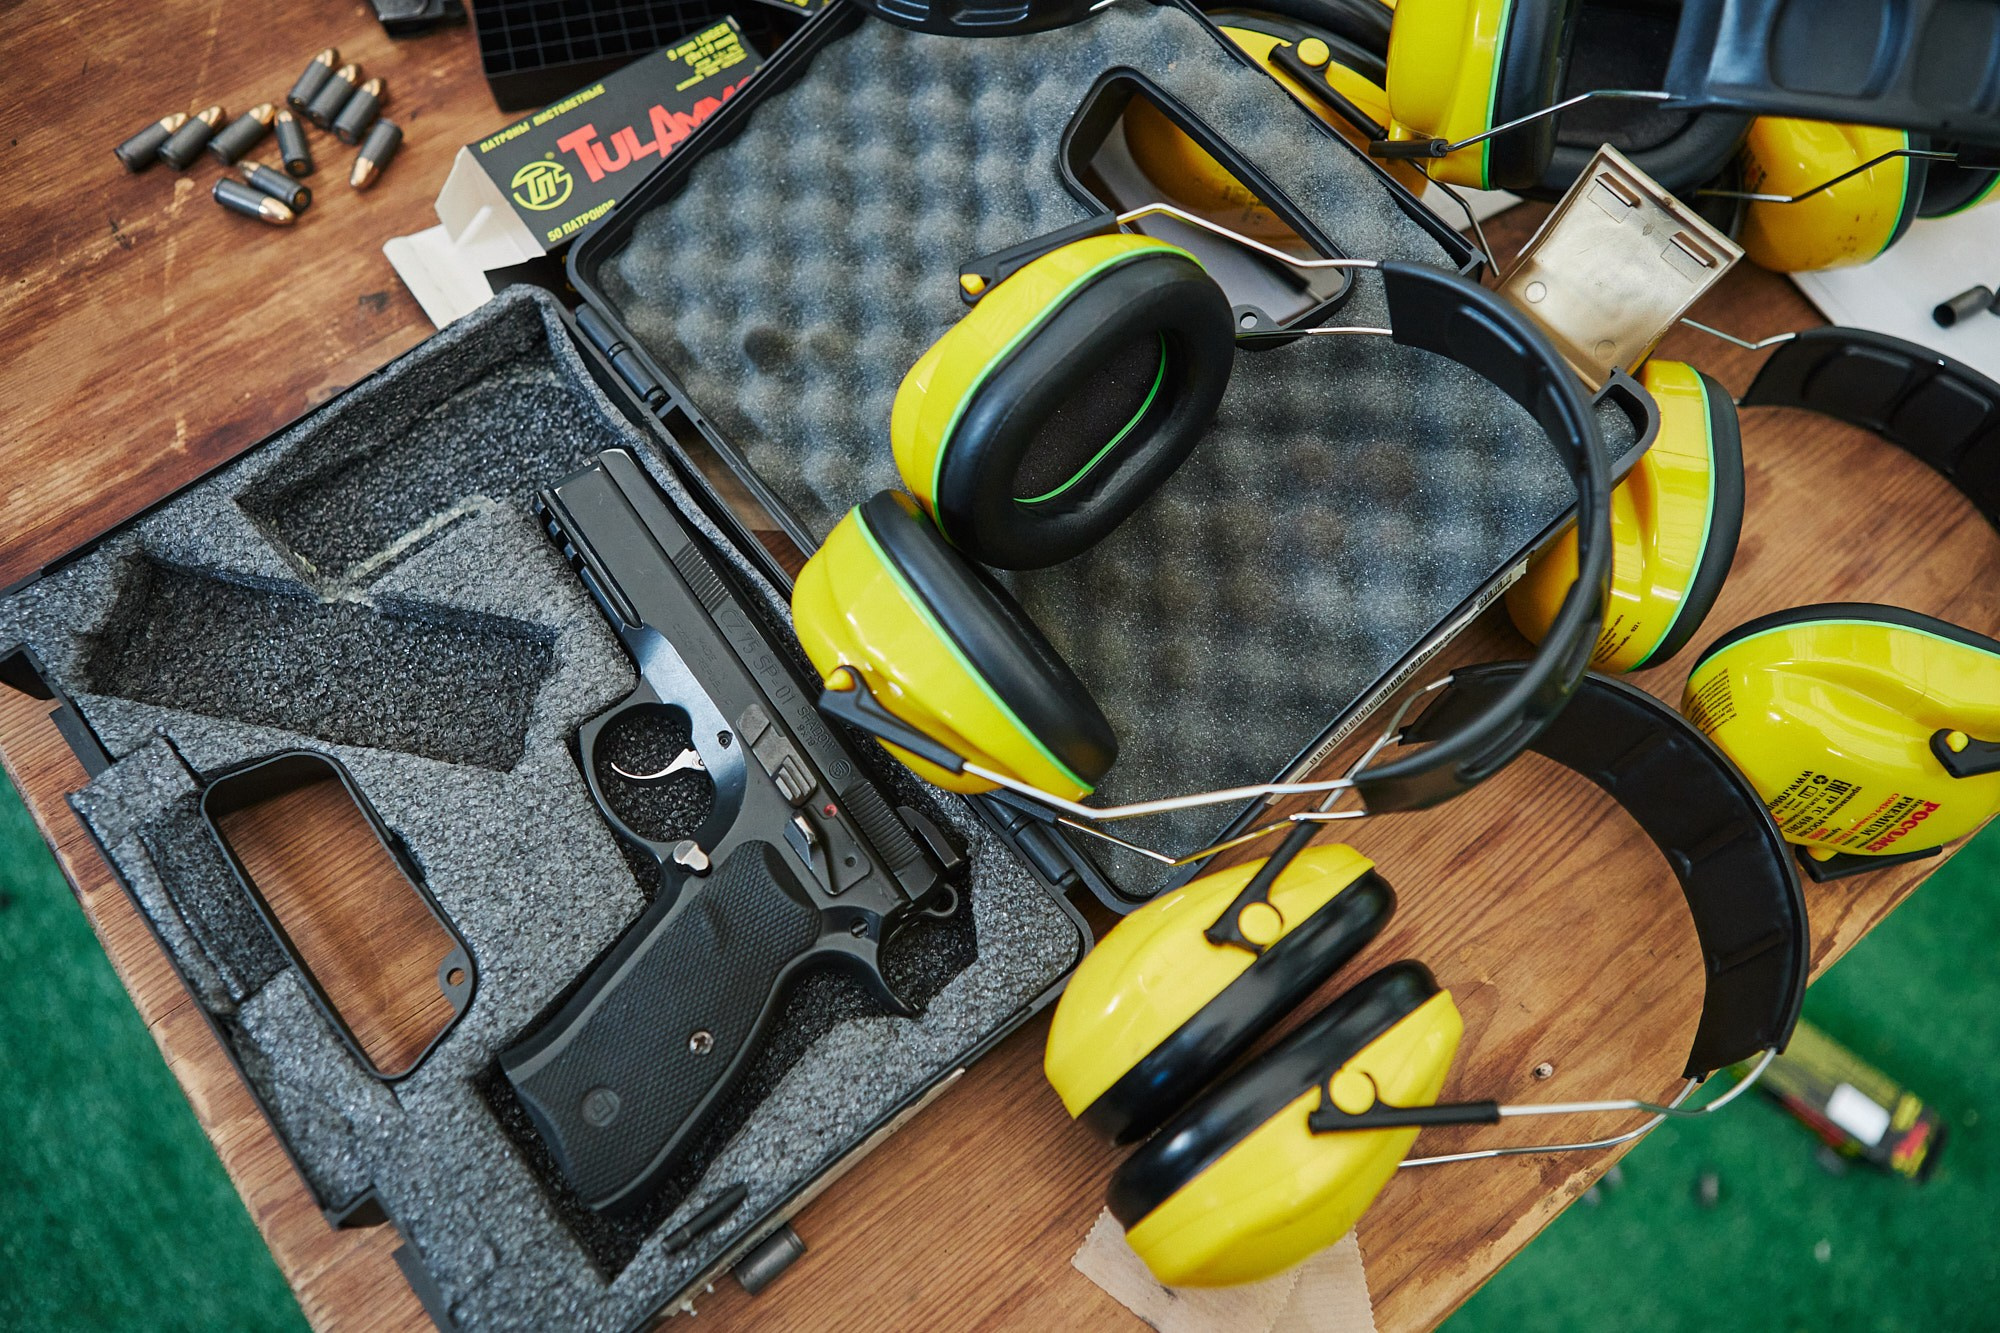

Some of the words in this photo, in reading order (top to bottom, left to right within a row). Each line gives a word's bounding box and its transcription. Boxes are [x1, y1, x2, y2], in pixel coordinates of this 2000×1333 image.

[480, 121, 531, 153] ПАТРОНЫ
[532, 83, 606, 127] ПИСТОЛЕТНЫЕ
[547, 229, 563, 242] 50
[720, 608, 746, 634] CZ
[737, 631, 762, 655] 75
[753, 655, 799, 707] SP-01
[797, 706, 838, 752] SHADOW
[1812, 806, 1828, 815] ТС
[1826, 795, 1840, 805] ТР
[1860, 796, 1914, 837] PREMIUM
